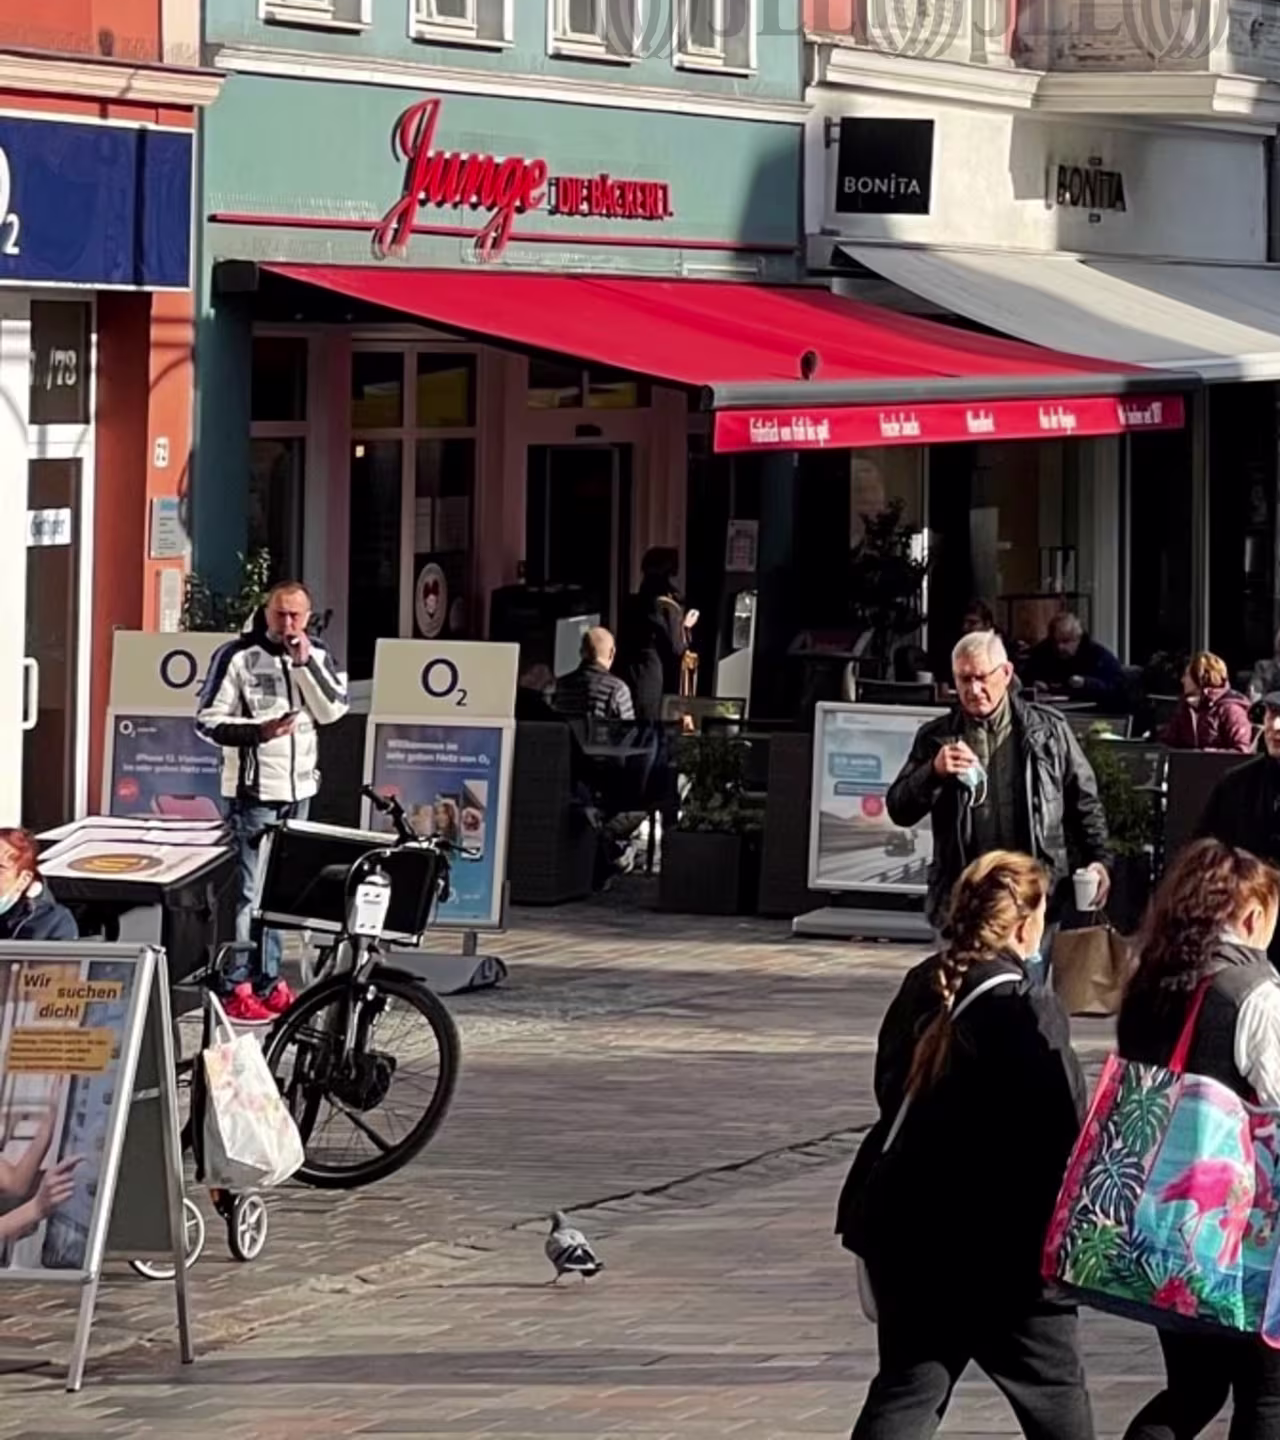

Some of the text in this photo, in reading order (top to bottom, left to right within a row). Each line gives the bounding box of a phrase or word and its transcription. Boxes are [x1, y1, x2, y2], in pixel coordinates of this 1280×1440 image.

[373, 97, 547, 261] Junge
[551, 176, 591, 216] DIE
[23, 974, 52, 988] Wir
[56, 985, 118, 999] suchen
[38, 1004, 80, 1018] dich!
